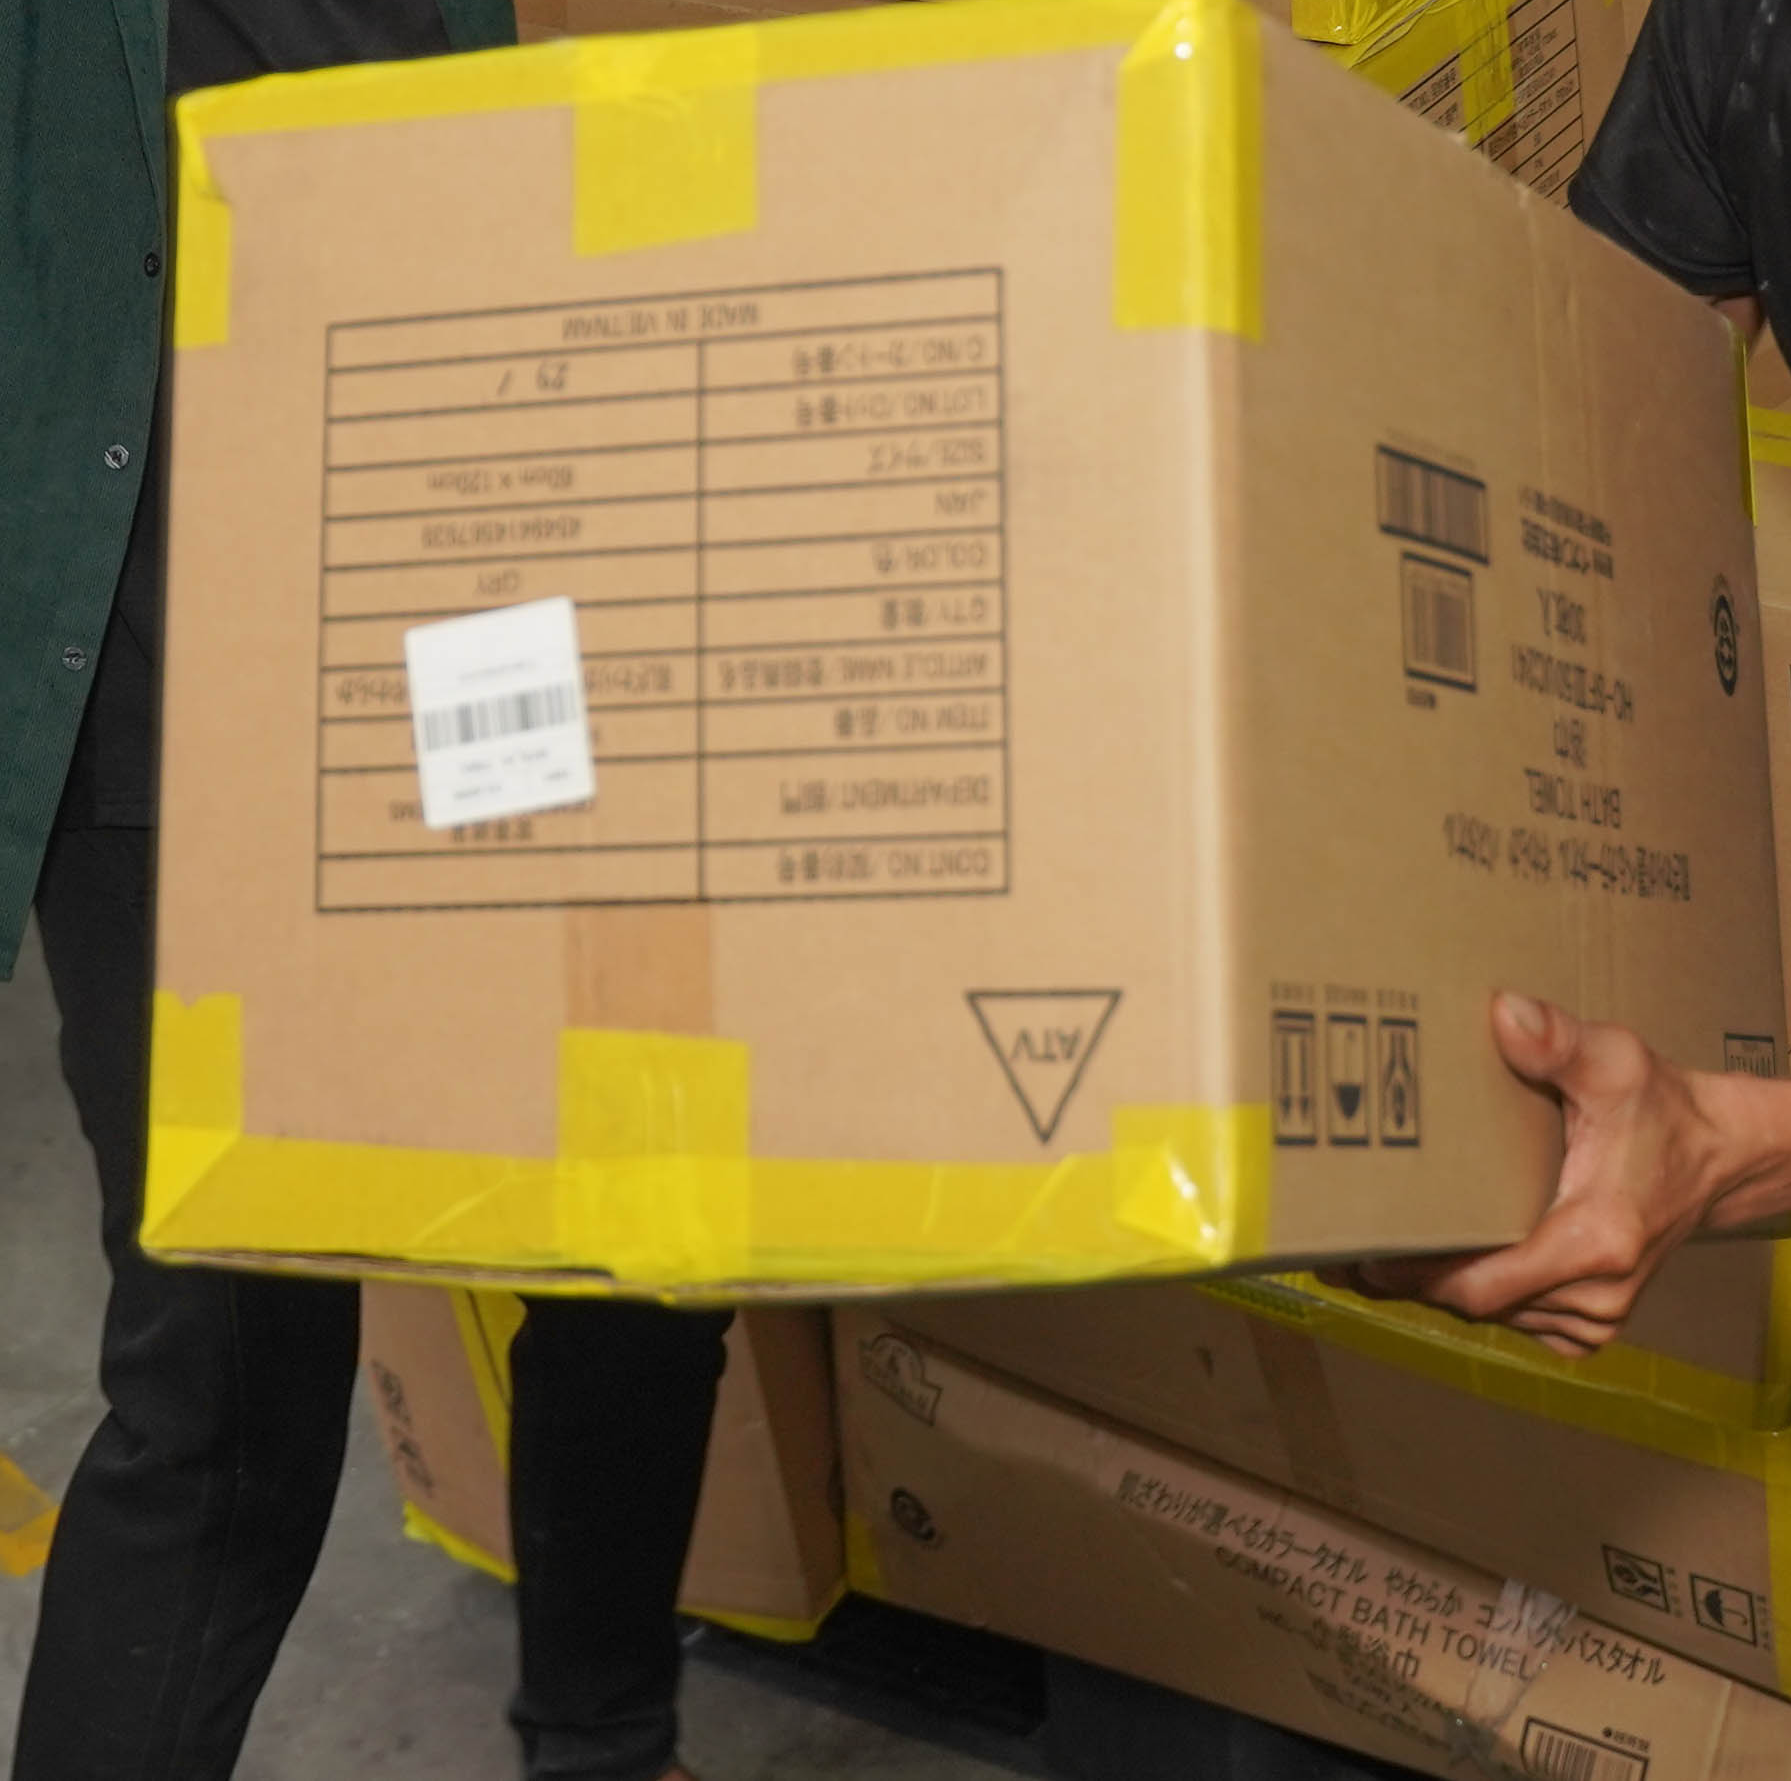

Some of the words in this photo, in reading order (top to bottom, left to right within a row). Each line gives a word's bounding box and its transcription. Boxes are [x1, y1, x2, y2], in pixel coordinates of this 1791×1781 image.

[561, 308, 660, 341] VIETNAM
[667, 306, 689, 335] IN
[695, 301, 760, 333] MADE
[934, 490, 990, 518] JAN
[1011, 1025, 1080, 1063] ATV
[1354, 1600, 1431, 1645] BATH
[1440, 1625, 1535, 1684] TOWEL
